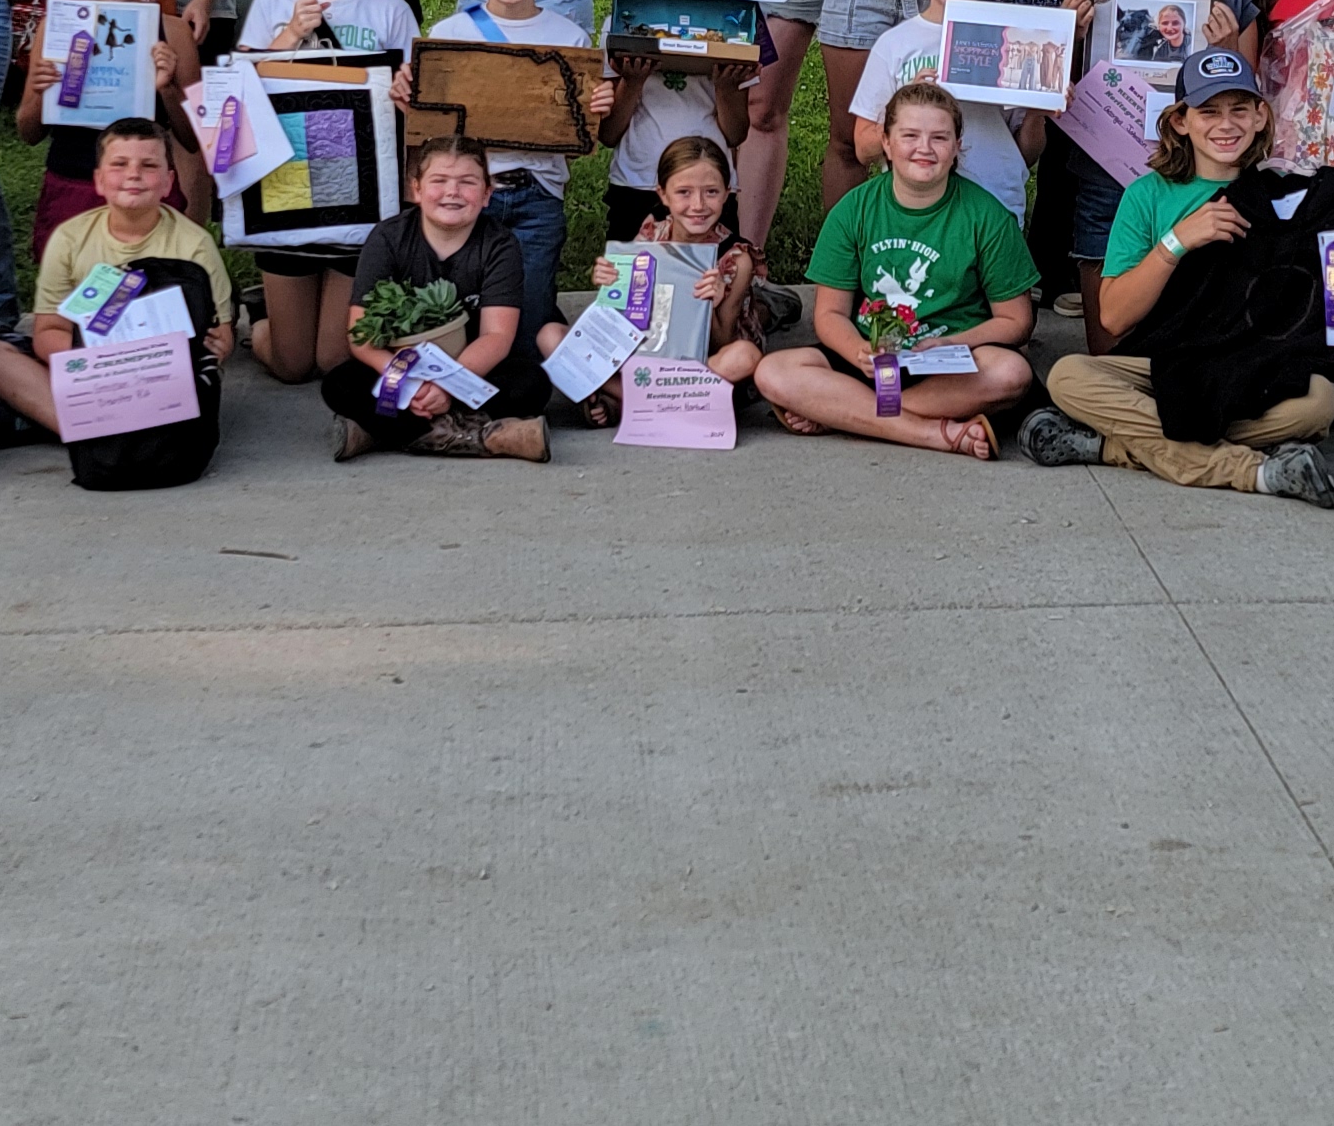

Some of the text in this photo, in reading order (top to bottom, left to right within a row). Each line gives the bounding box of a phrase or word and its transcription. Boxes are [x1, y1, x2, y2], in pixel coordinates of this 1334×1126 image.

[958, 54, 993, 67] STYLE
[871, 238, 940, 262] FLYIN' HIGH
[655, 376, 722, 386] CHAMPION
[646, 392, 681, 400] Heritage
